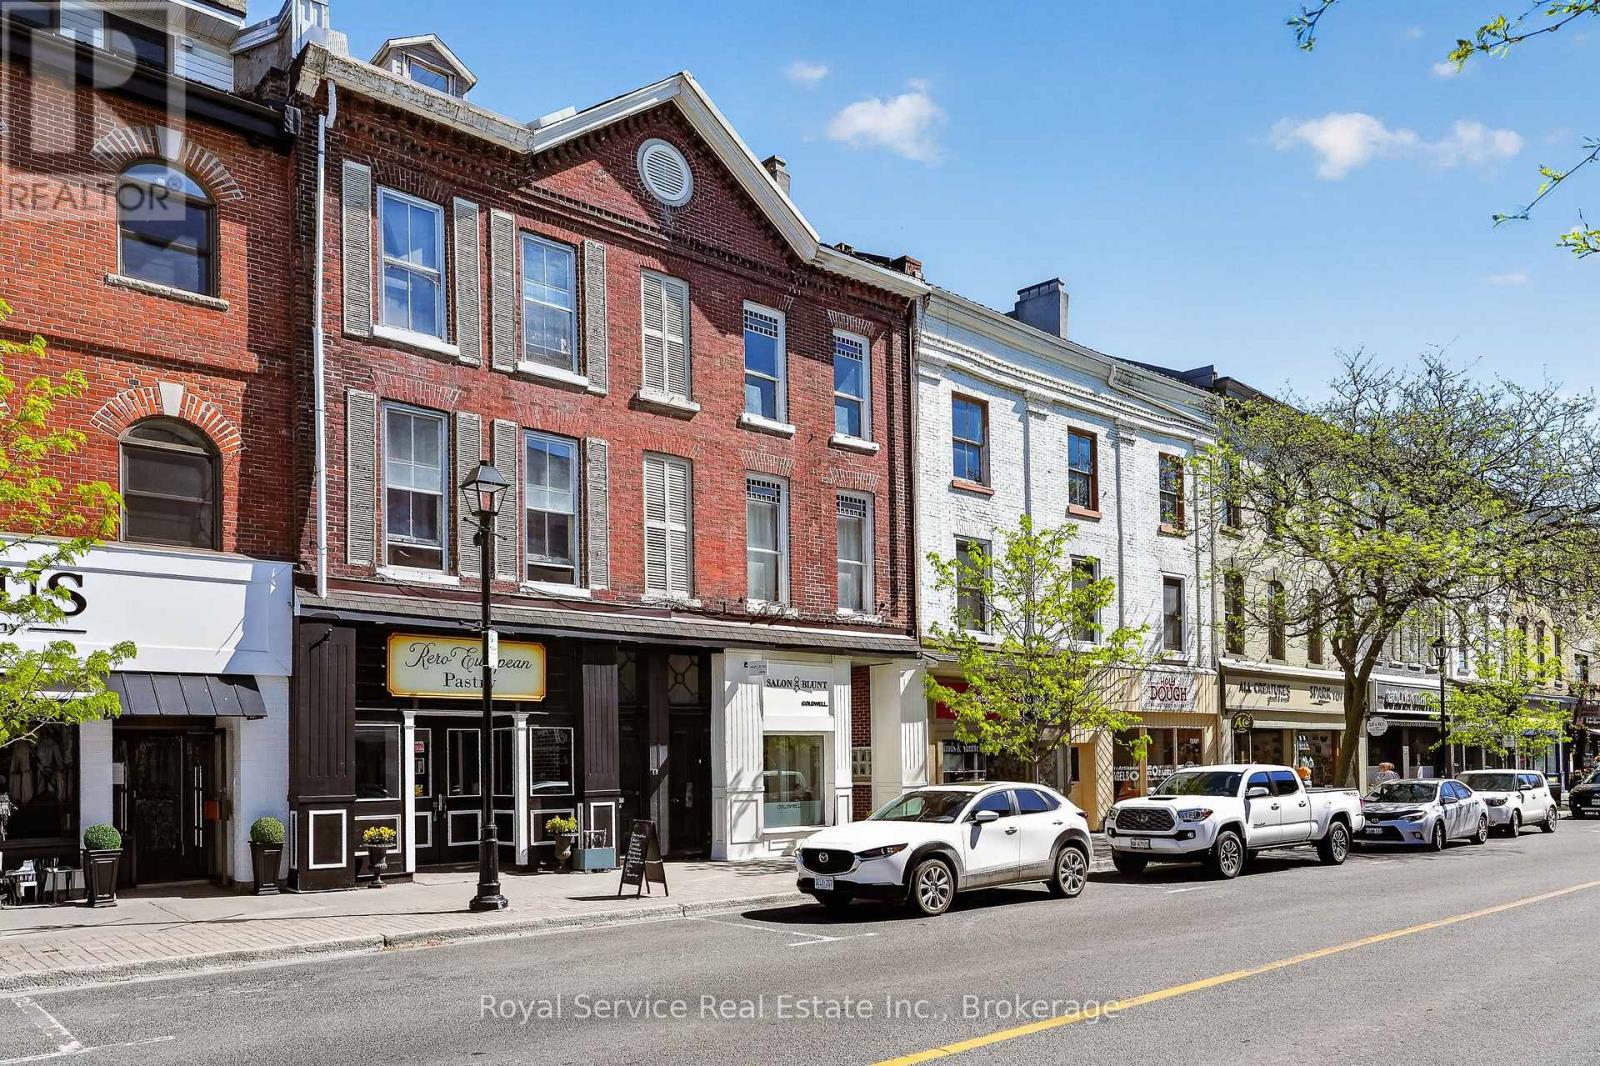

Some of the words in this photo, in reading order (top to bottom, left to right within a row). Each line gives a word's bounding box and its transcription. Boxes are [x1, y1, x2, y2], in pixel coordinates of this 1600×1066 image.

[404, 642, 452, 671] Rero
[450, 646, 532, 675] Eupean
[766, 678, 793, 688] SALON
[800, 680, 828, 689] BLUNT
[1253, 682, 1291, 696] CREATURES
[1150, 686, 1187, 702] DOUGH
